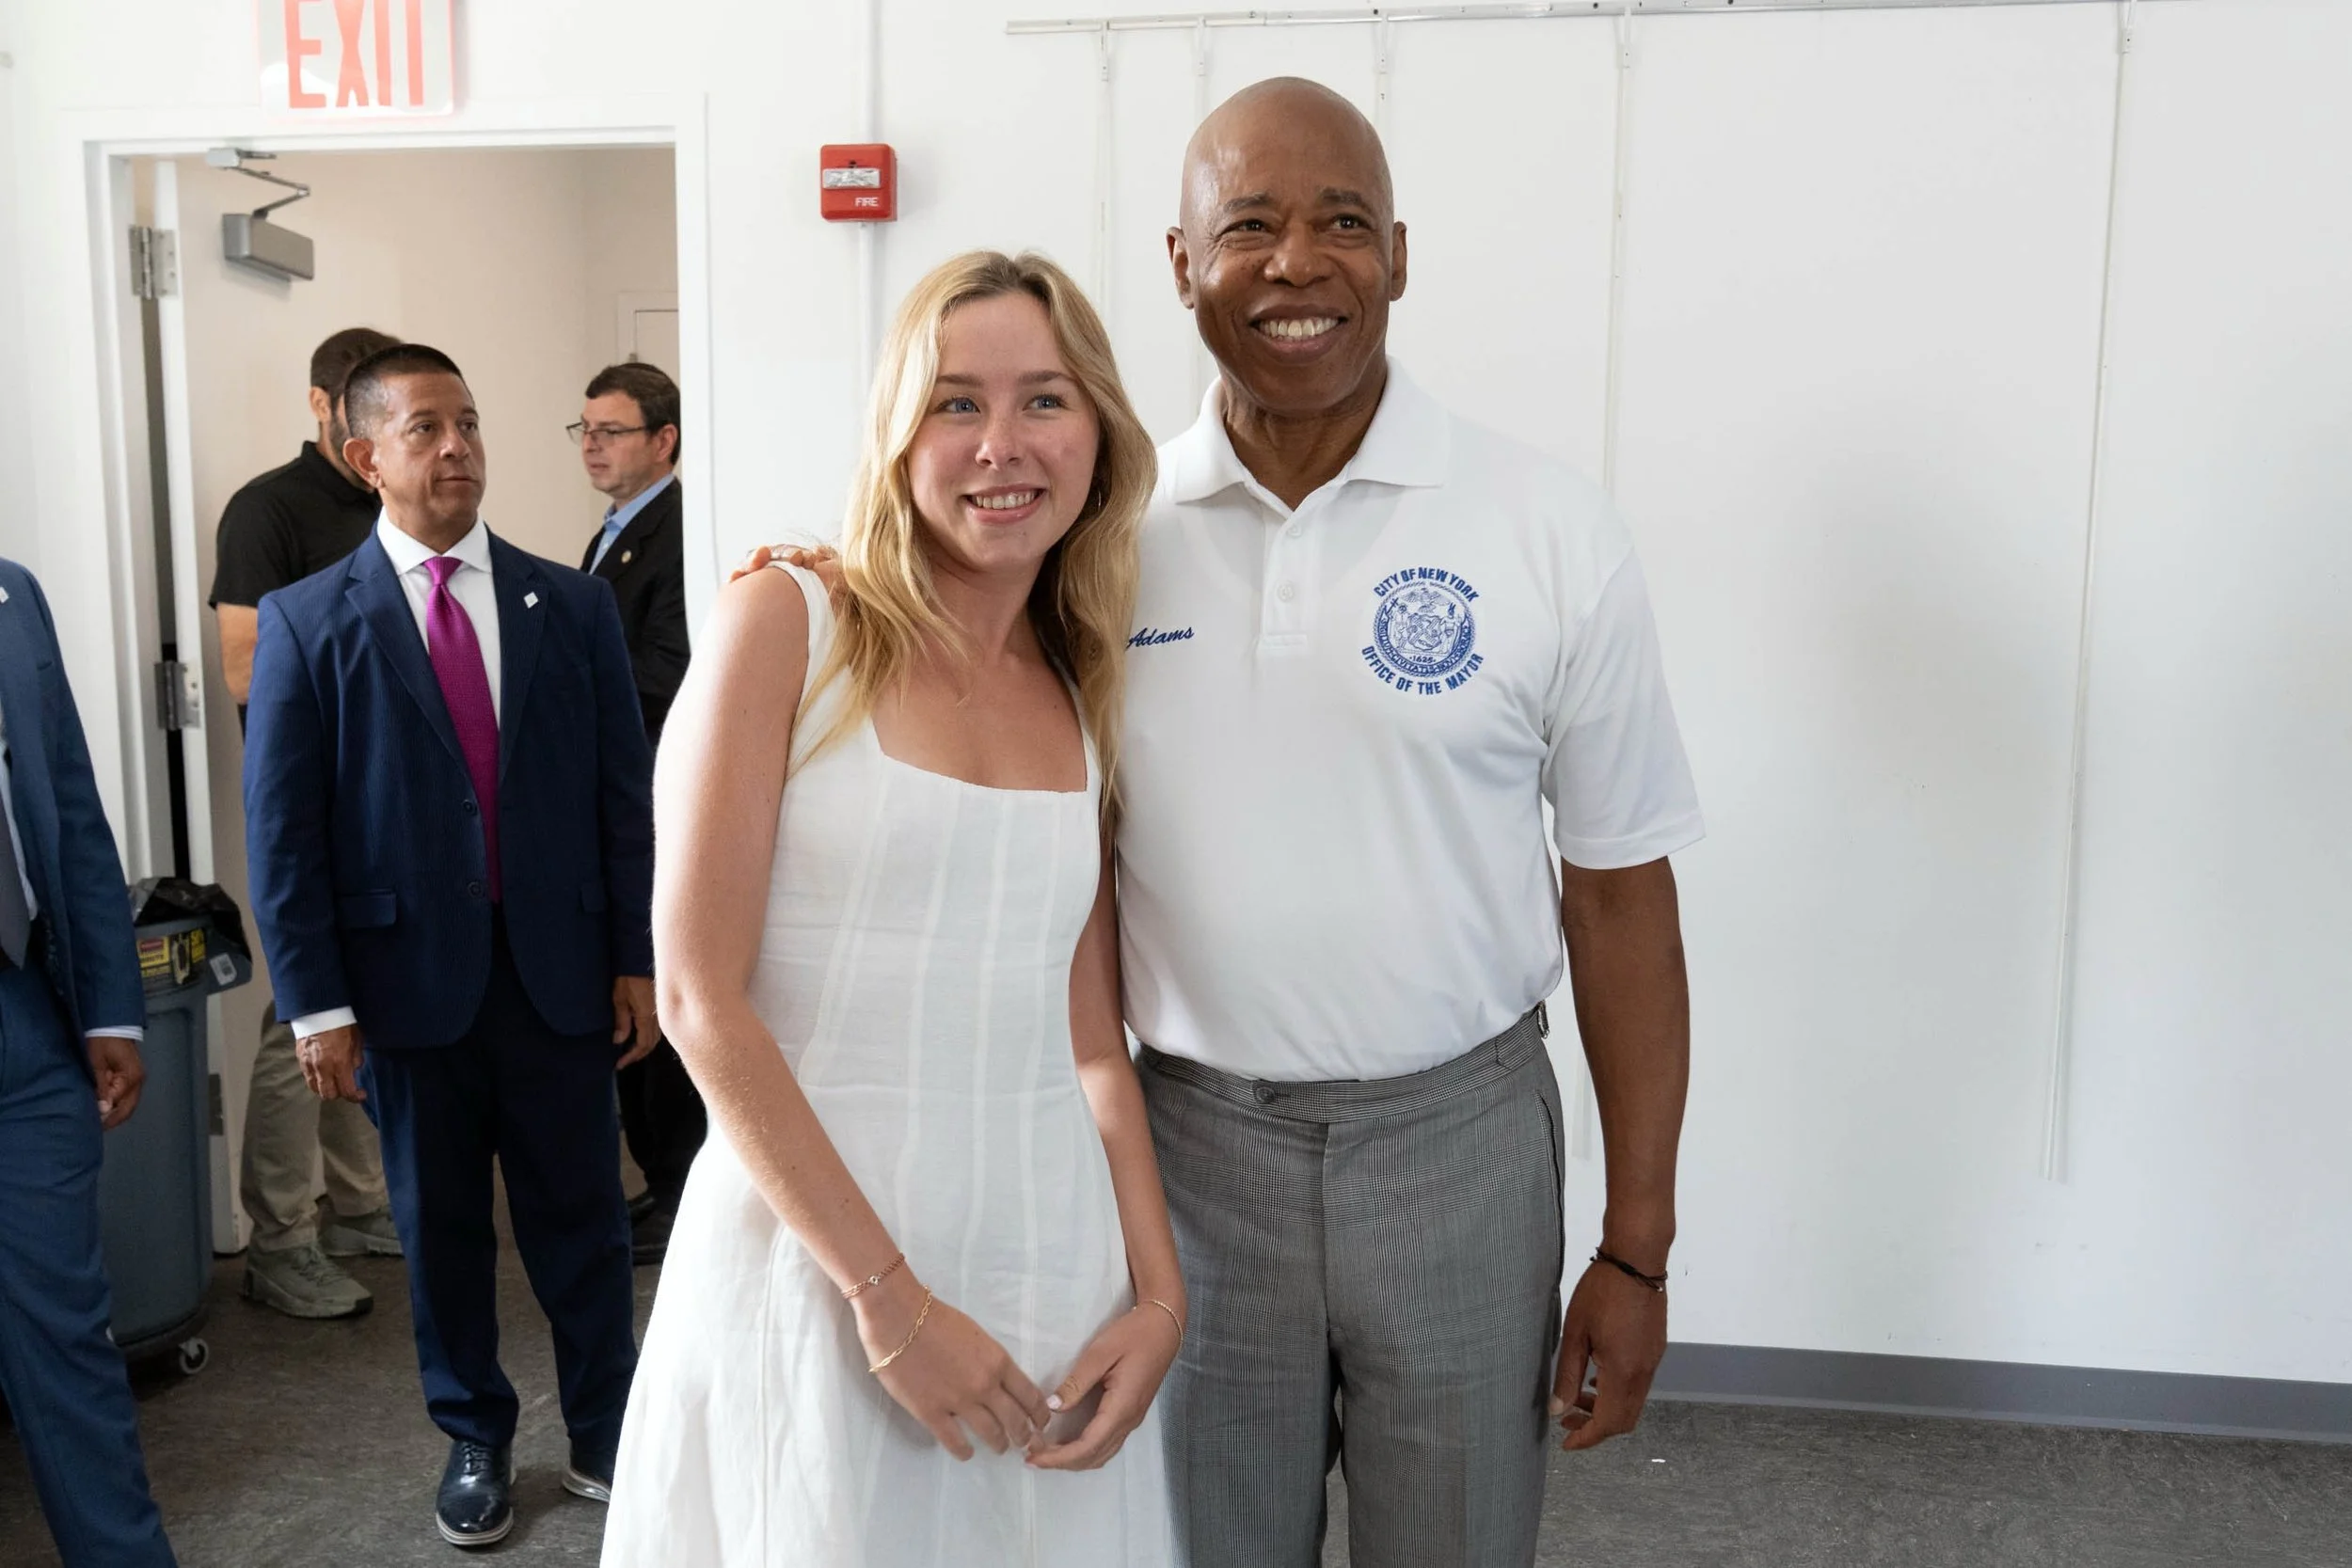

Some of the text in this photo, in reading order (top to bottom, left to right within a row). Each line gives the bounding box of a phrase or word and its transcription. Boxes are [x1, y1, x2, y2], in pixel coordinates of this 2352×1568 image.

[854, 197, 879, 207] FIRE
[1374, 566, 1480, 603] CITY OF NEW YORK
[1126, 626, 1195, 650] Adams
[1361, 645, 1485, 696] OFFICE OF THE MAYOR
[1412, 656, 1434, 664] 1625
